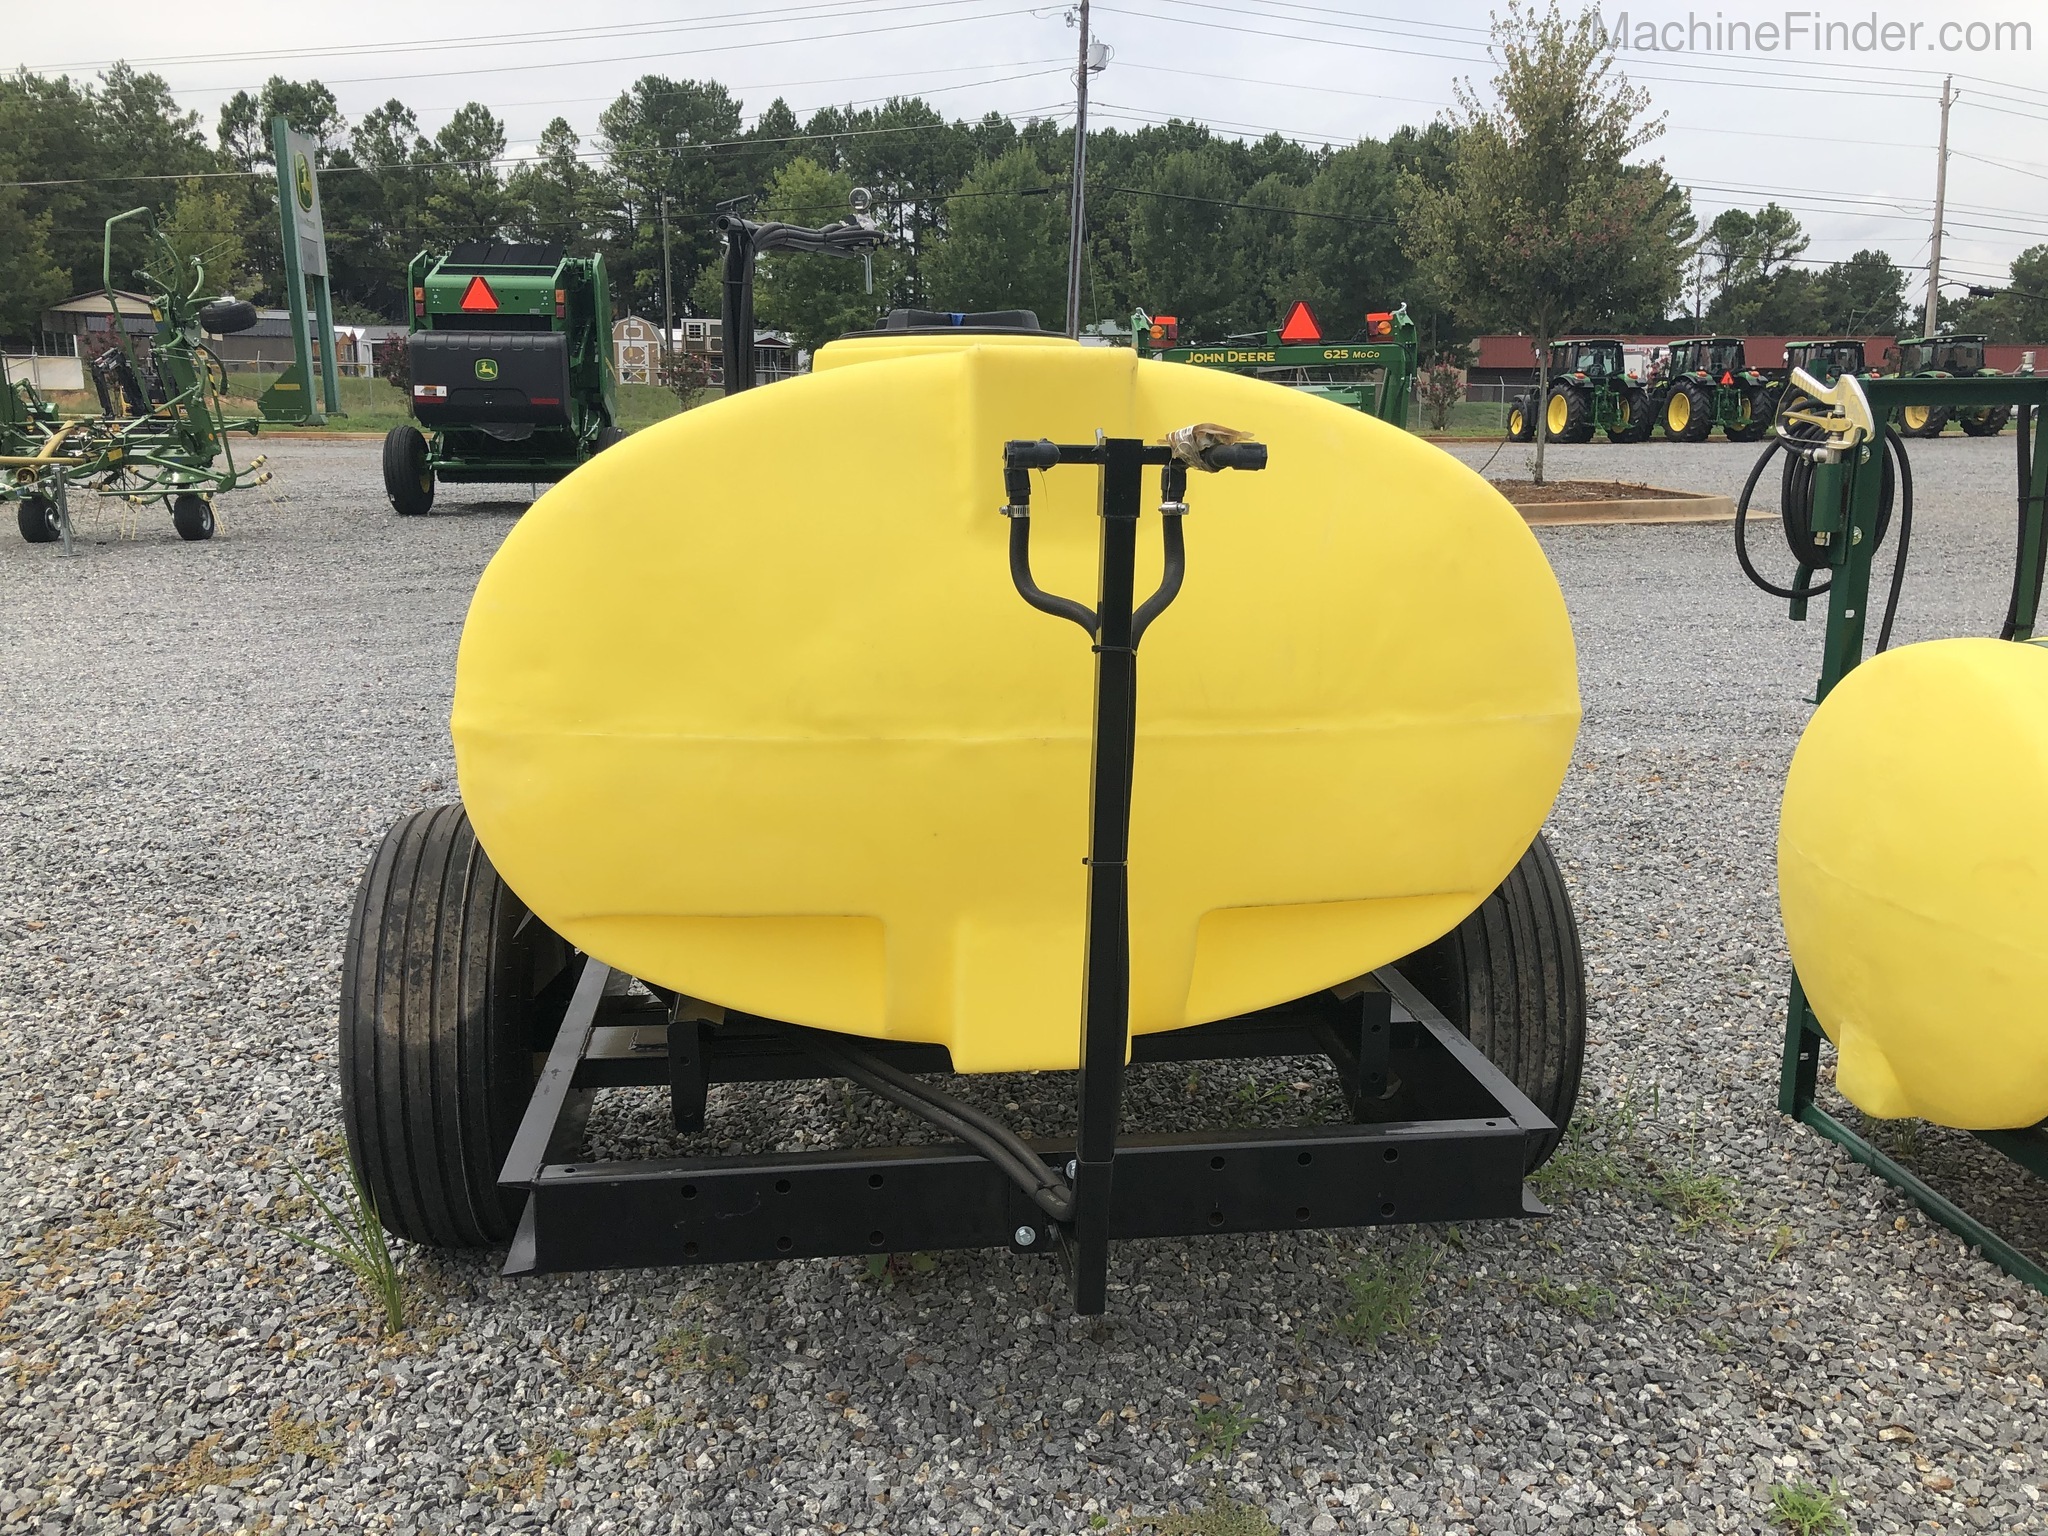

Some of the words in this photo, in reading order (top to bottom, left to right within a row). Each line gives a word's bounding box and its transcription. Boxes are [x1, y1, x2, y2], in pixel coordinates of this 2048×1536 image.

[1185, 351, 1225, 364] JOHN
[1227, 351, 1276, 362] DEERE
[1323, 349, 1349, 359] 625
[1352, 350, 1380, 359] MoCo
